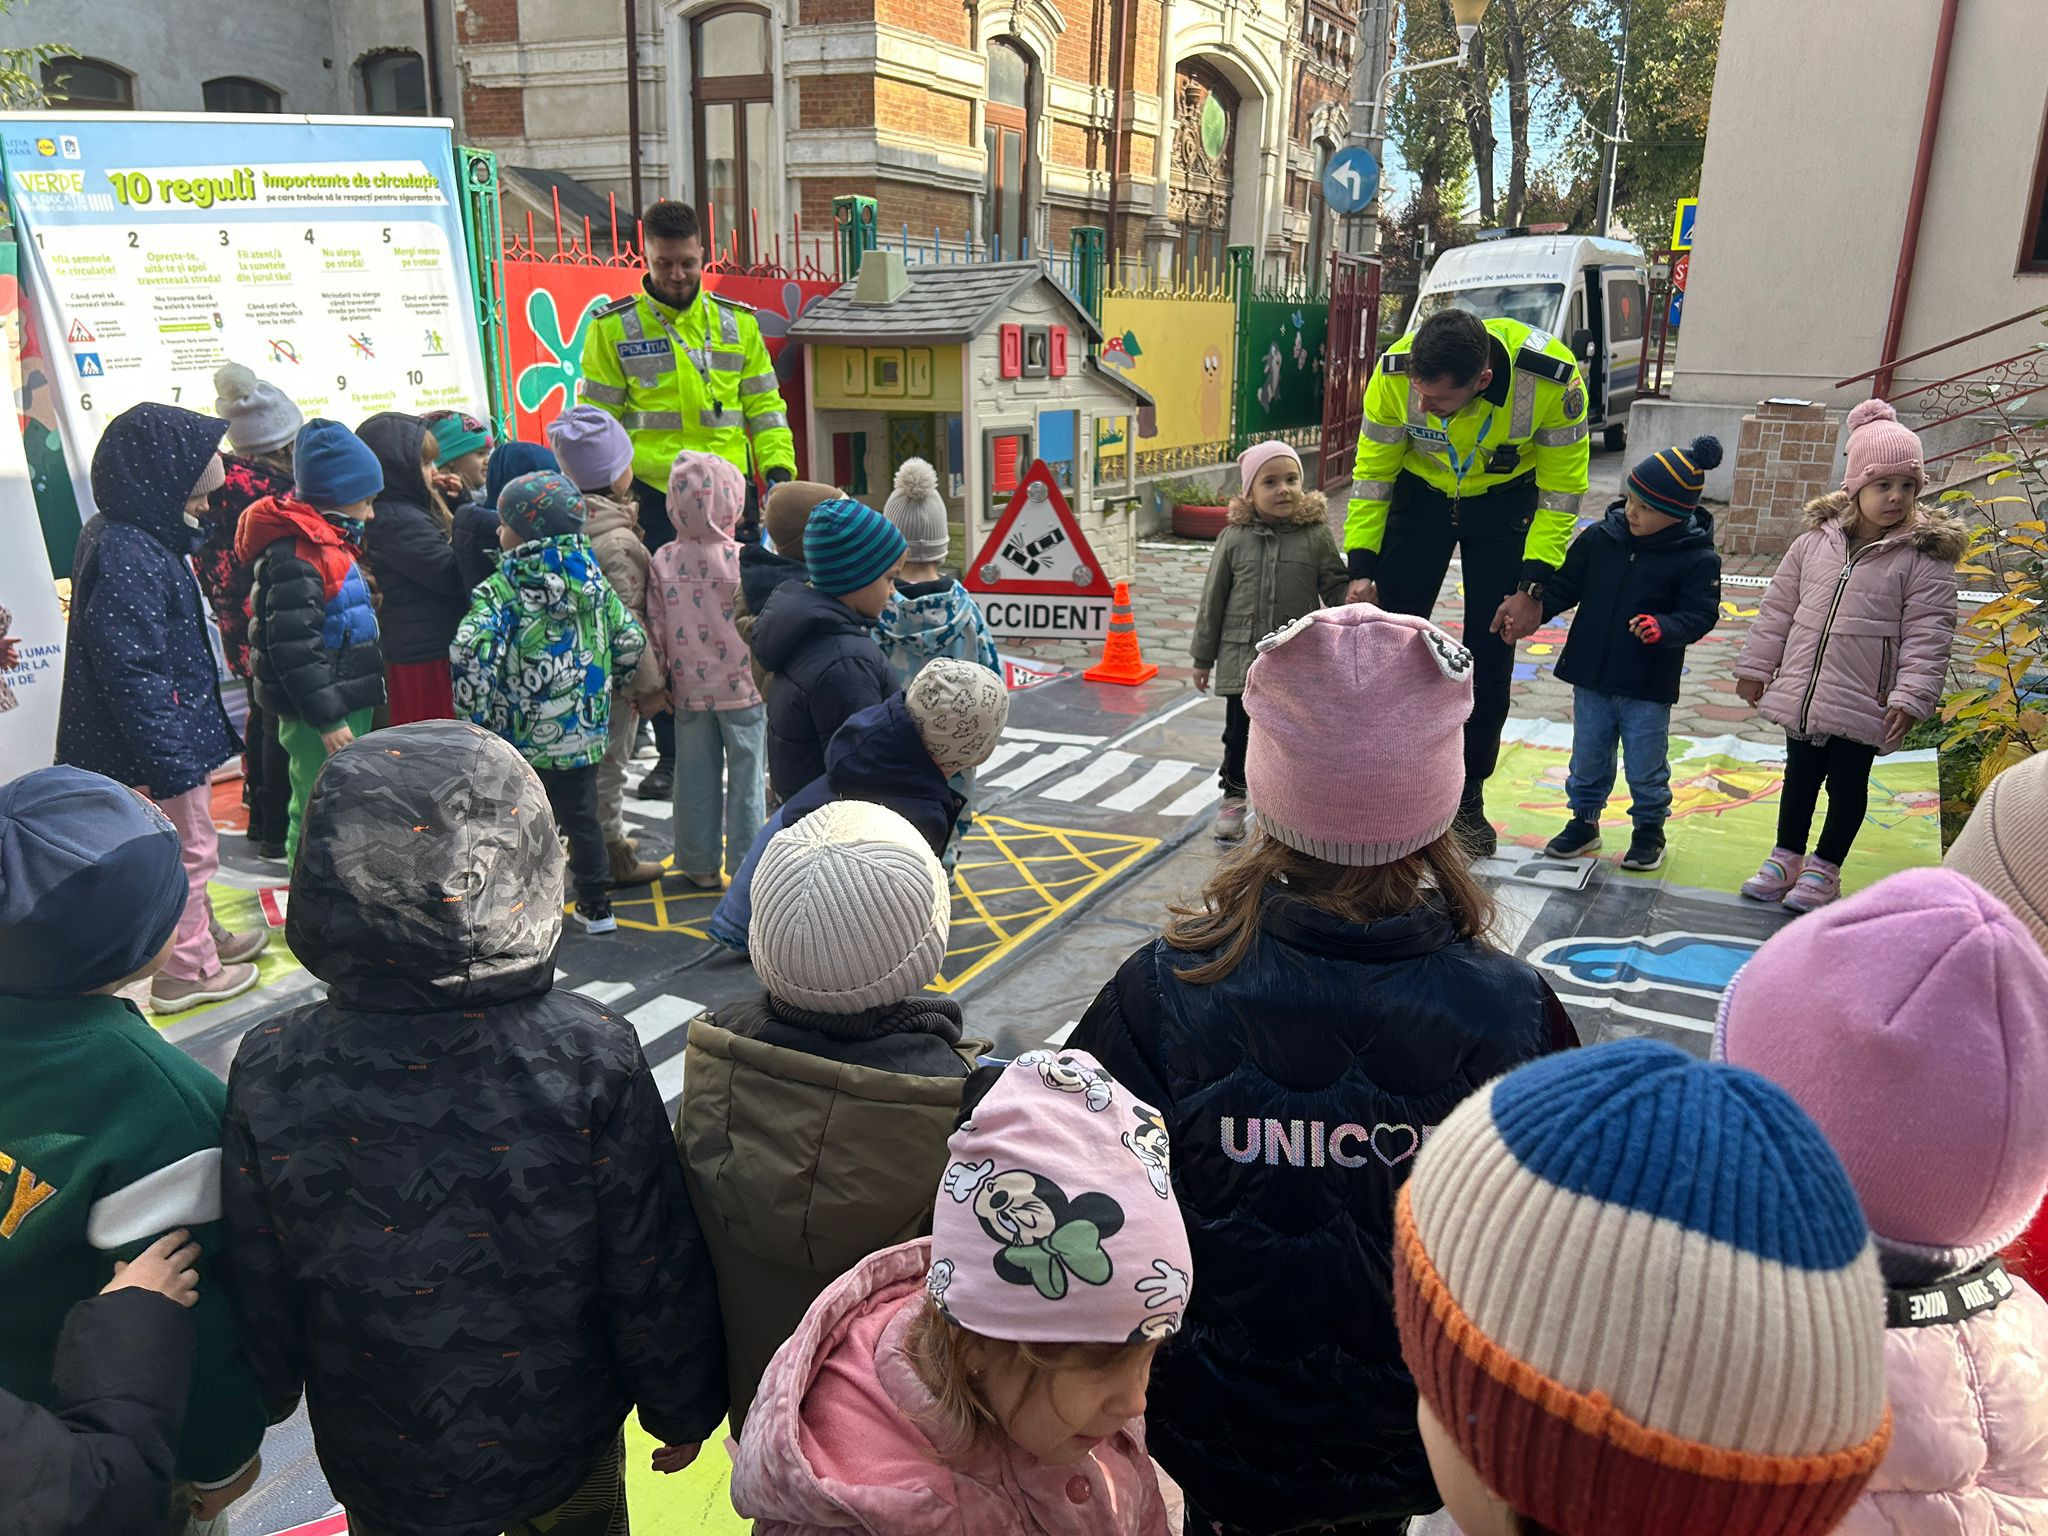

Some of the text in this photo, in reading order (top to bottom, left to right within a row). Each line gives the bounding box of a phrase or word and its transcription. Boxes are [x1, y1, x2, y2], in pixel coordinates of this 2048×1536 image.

[19, 172, 84, 192] VERDE
[108, 167, 256, 209] 10 reguli
[262, 171, 440, 193] importante de circulație
[266, 194, 277, 203] pe
[278, 194, 295, 202] care
[297, 193, 324, 202] trebuie
[336, 193, 342, 201] le
[374, 194, 398, 204] pentru
[35, 233, 46, 250] 1
[128, 231, 140, 248] 2
[219, 230, 230, 246] 3
[304, 228, 316, 244] 4
[382, 228, 393, 244] 5
[71, 253, 112, 264] semnele
[322, 248, 362, 261] Nu alerga
[394, 247, 441, 258] Mergi mereu
[188, 262, 208, 275] apoi
[239, 260, 286, 271] la sunetele
[325, 260, 336, 270] pe
[402, 259, 412, 269] pe
[1675, 263, 1688, 281] S
[138, 273, 222, 287] traversează strada!
[237, 273, 250, 283] din
[1535, 272, 1560, 280] TALE
[337, 375, 347, 391] 9
[406, 369, 424, 386] 10
[80, 393, 93, 411] 6
[171, 387, 182, 402] 7
[985, 602, 1108, 632] CCIDENT
[25, 643, 62, 659] UMAN
[32, 658, 50, 670] LA
[18, 673, 37, 685] DE
[1908, 1289, 1949, 1321] NIKE
